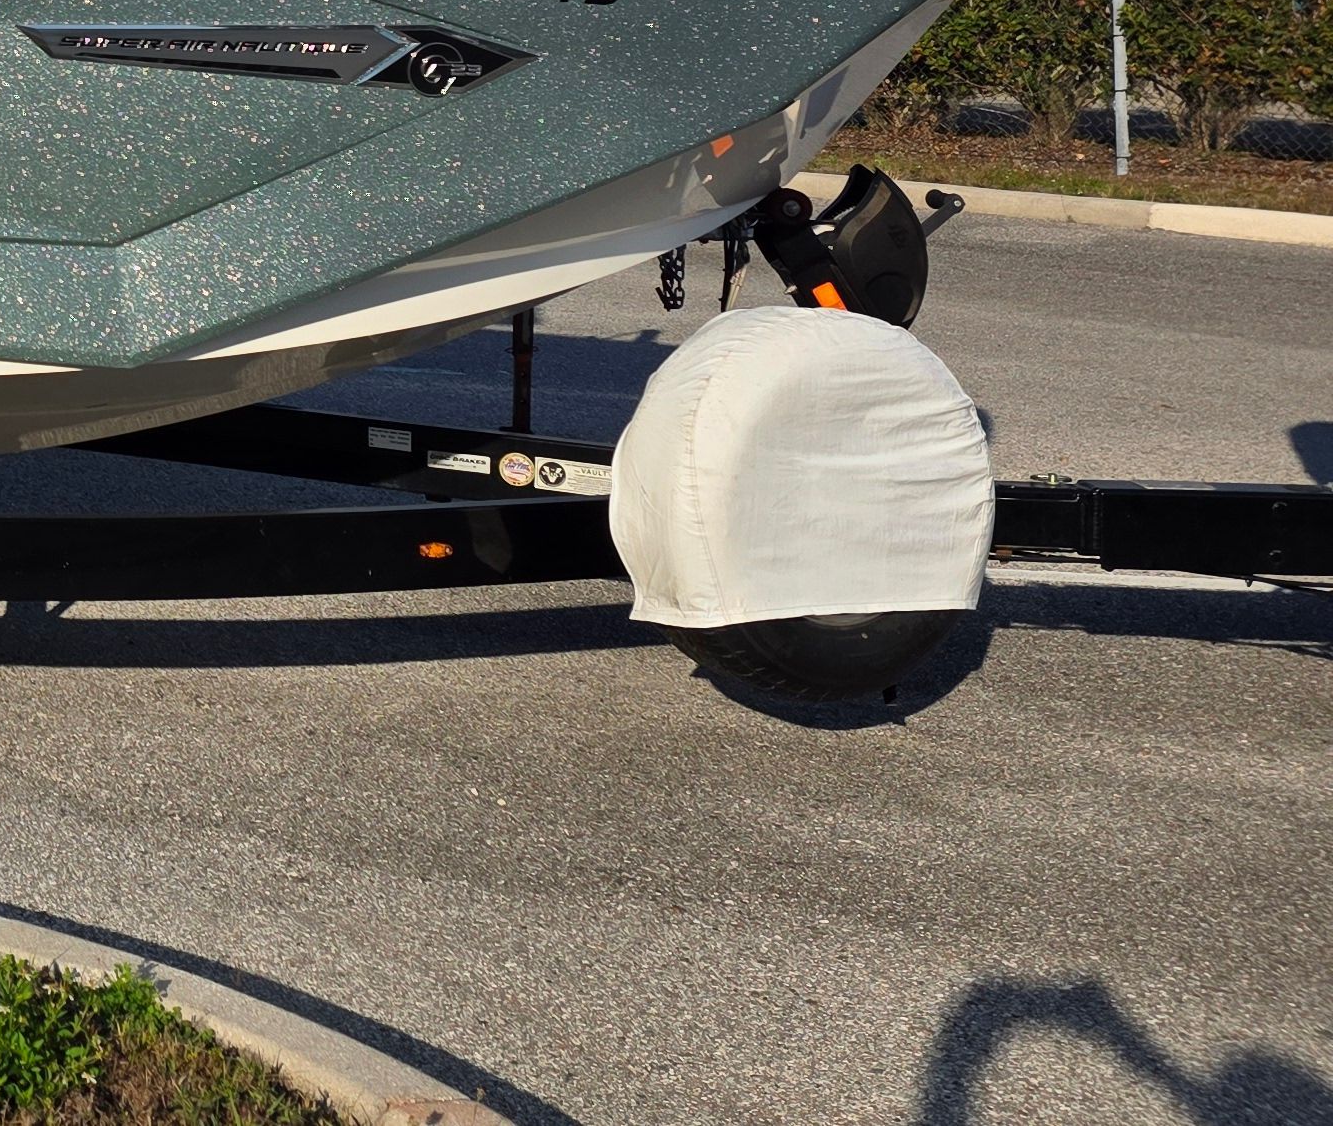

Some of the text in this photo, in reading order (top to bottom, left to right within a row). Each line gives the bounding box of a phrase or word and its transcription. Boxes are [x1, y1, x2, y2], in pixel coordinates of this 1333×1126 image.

[59, 35, 369, 55] SUPER AIR NAUTIQUE
[452, 456, 487, 465] BRAKES
[580, 468, 608, 478] VAULT
